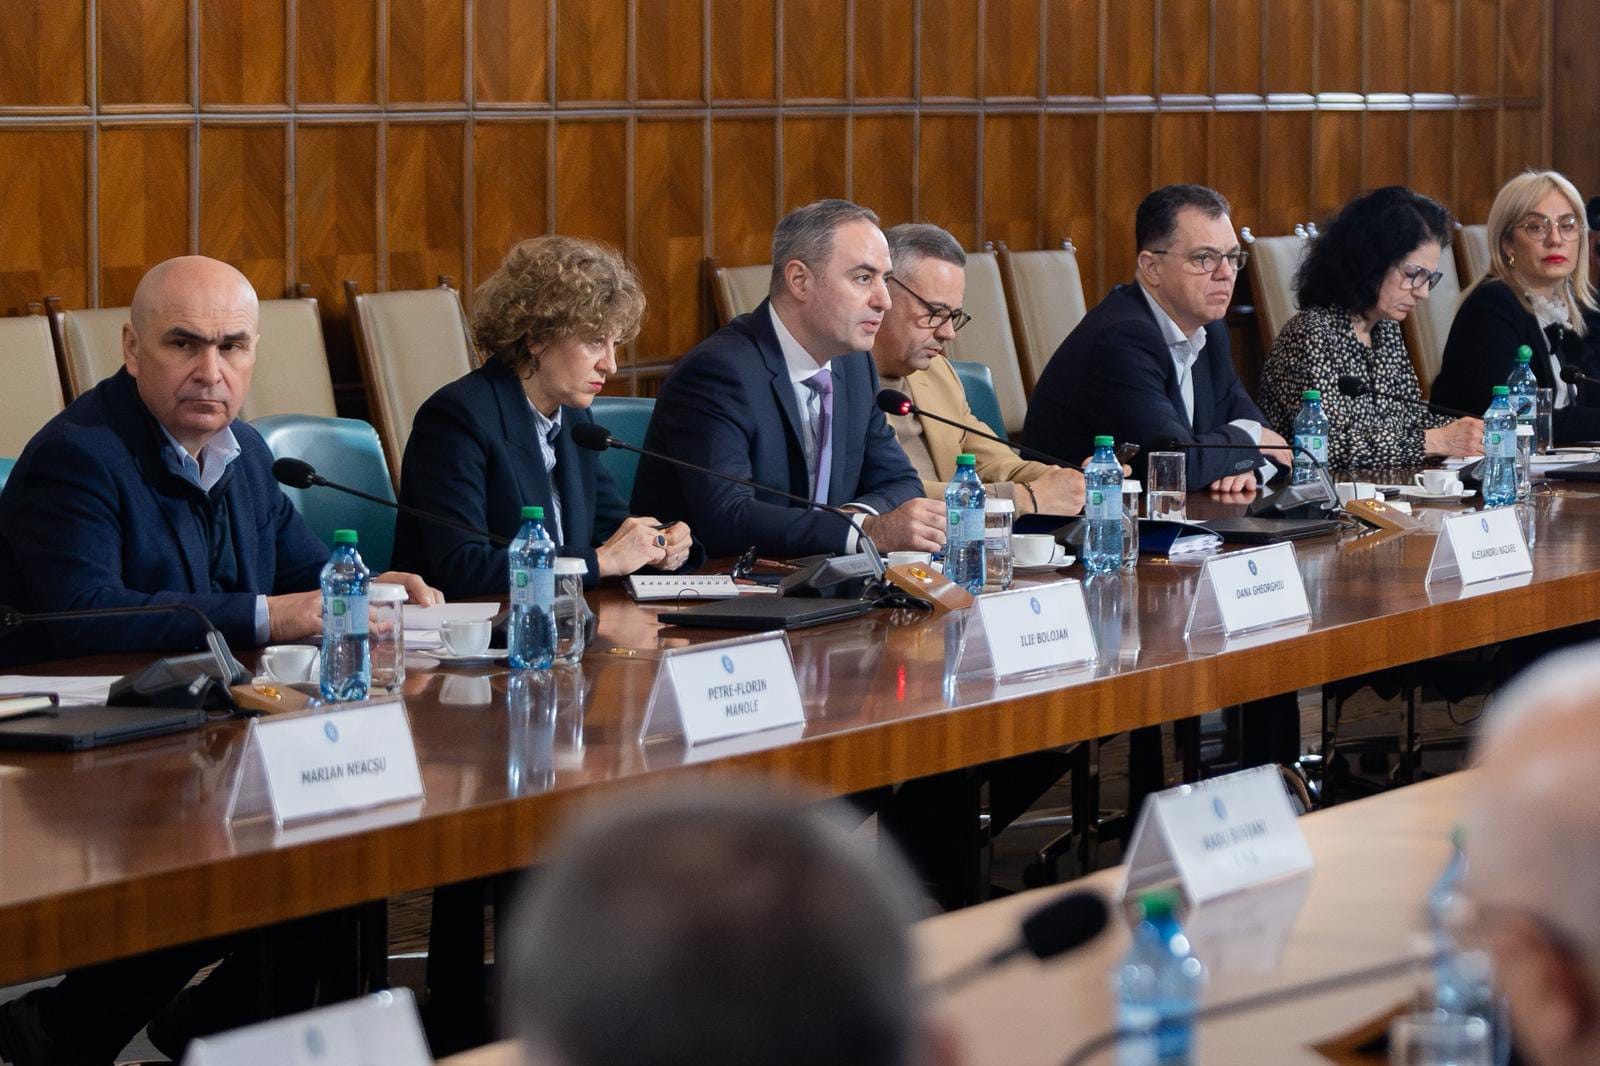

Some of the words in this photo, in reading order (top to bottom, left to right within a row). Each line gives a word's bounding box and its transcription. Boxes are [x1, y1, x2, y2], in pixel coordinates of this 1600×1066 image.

[1252, 580, 1285, 595] GHEORGHIU
[1020, 634, 1035, 647] ILIE
[1036, 628, 1069, 644] BOLOJAN
[708, 679, 767, 699] PETRE-FLORIN
[725, 700, 759, 717] MANOLE
[302, 765, 344, 785] MARIAN
